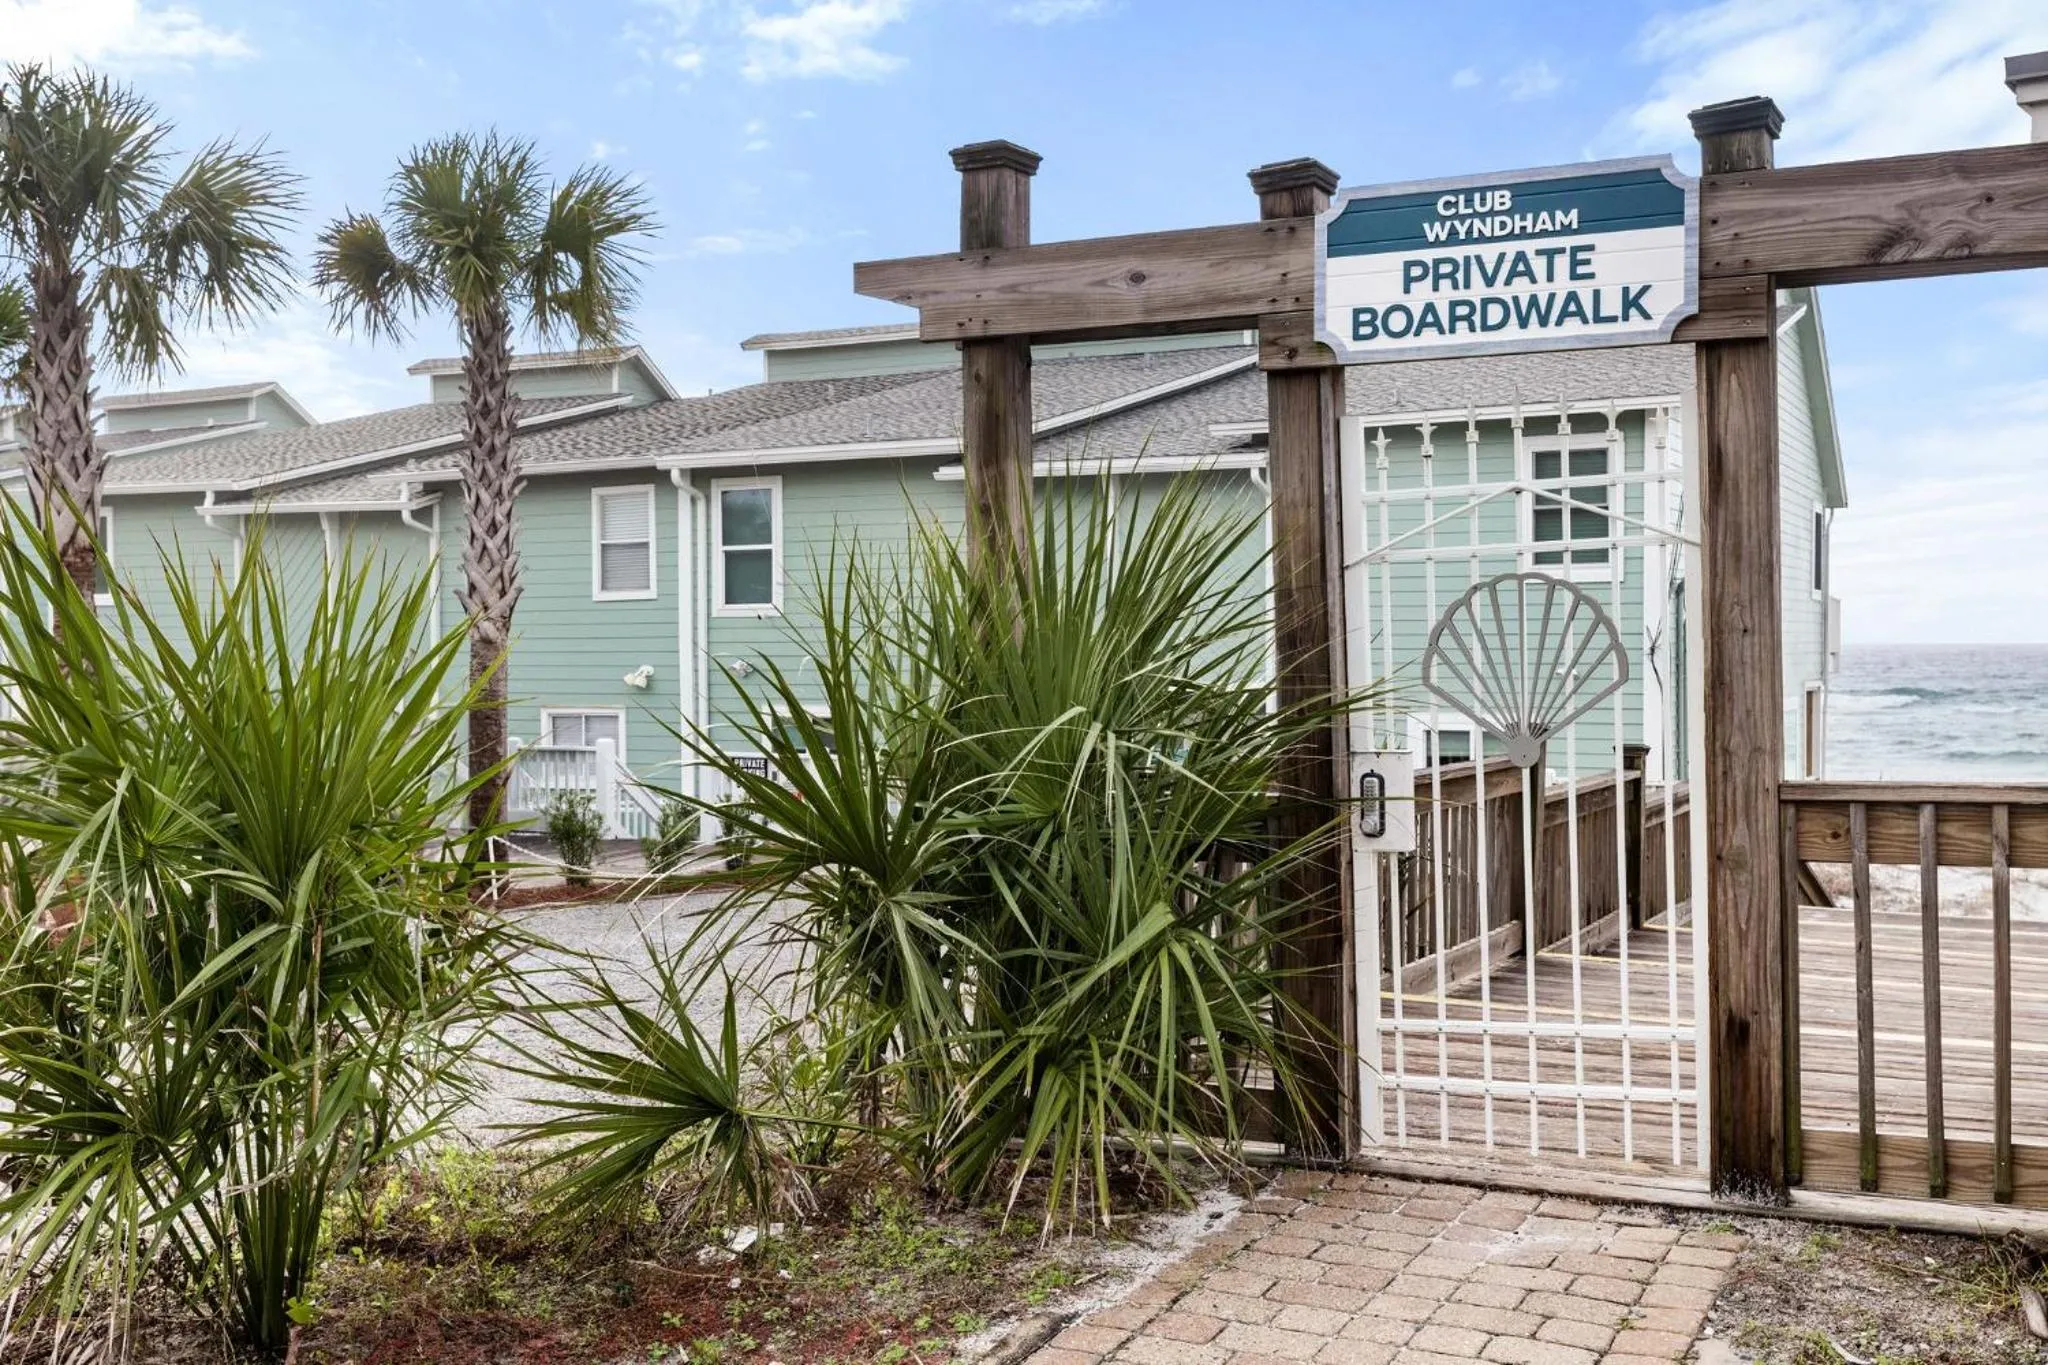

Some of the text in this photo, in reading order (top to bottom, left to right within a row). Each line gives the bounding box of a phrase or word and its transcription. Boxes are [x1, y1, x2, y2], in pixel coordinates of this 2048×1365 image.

[1437, 189, 1512, 216] CLUB
[1422, 208, 1579, 242] WYNDHAM
[1402, 244, 1597, 294] PRIVATE
[1352, 284, 1654, 341] BOARDWALK
[734, 758, 765, 768] PRIVATE
